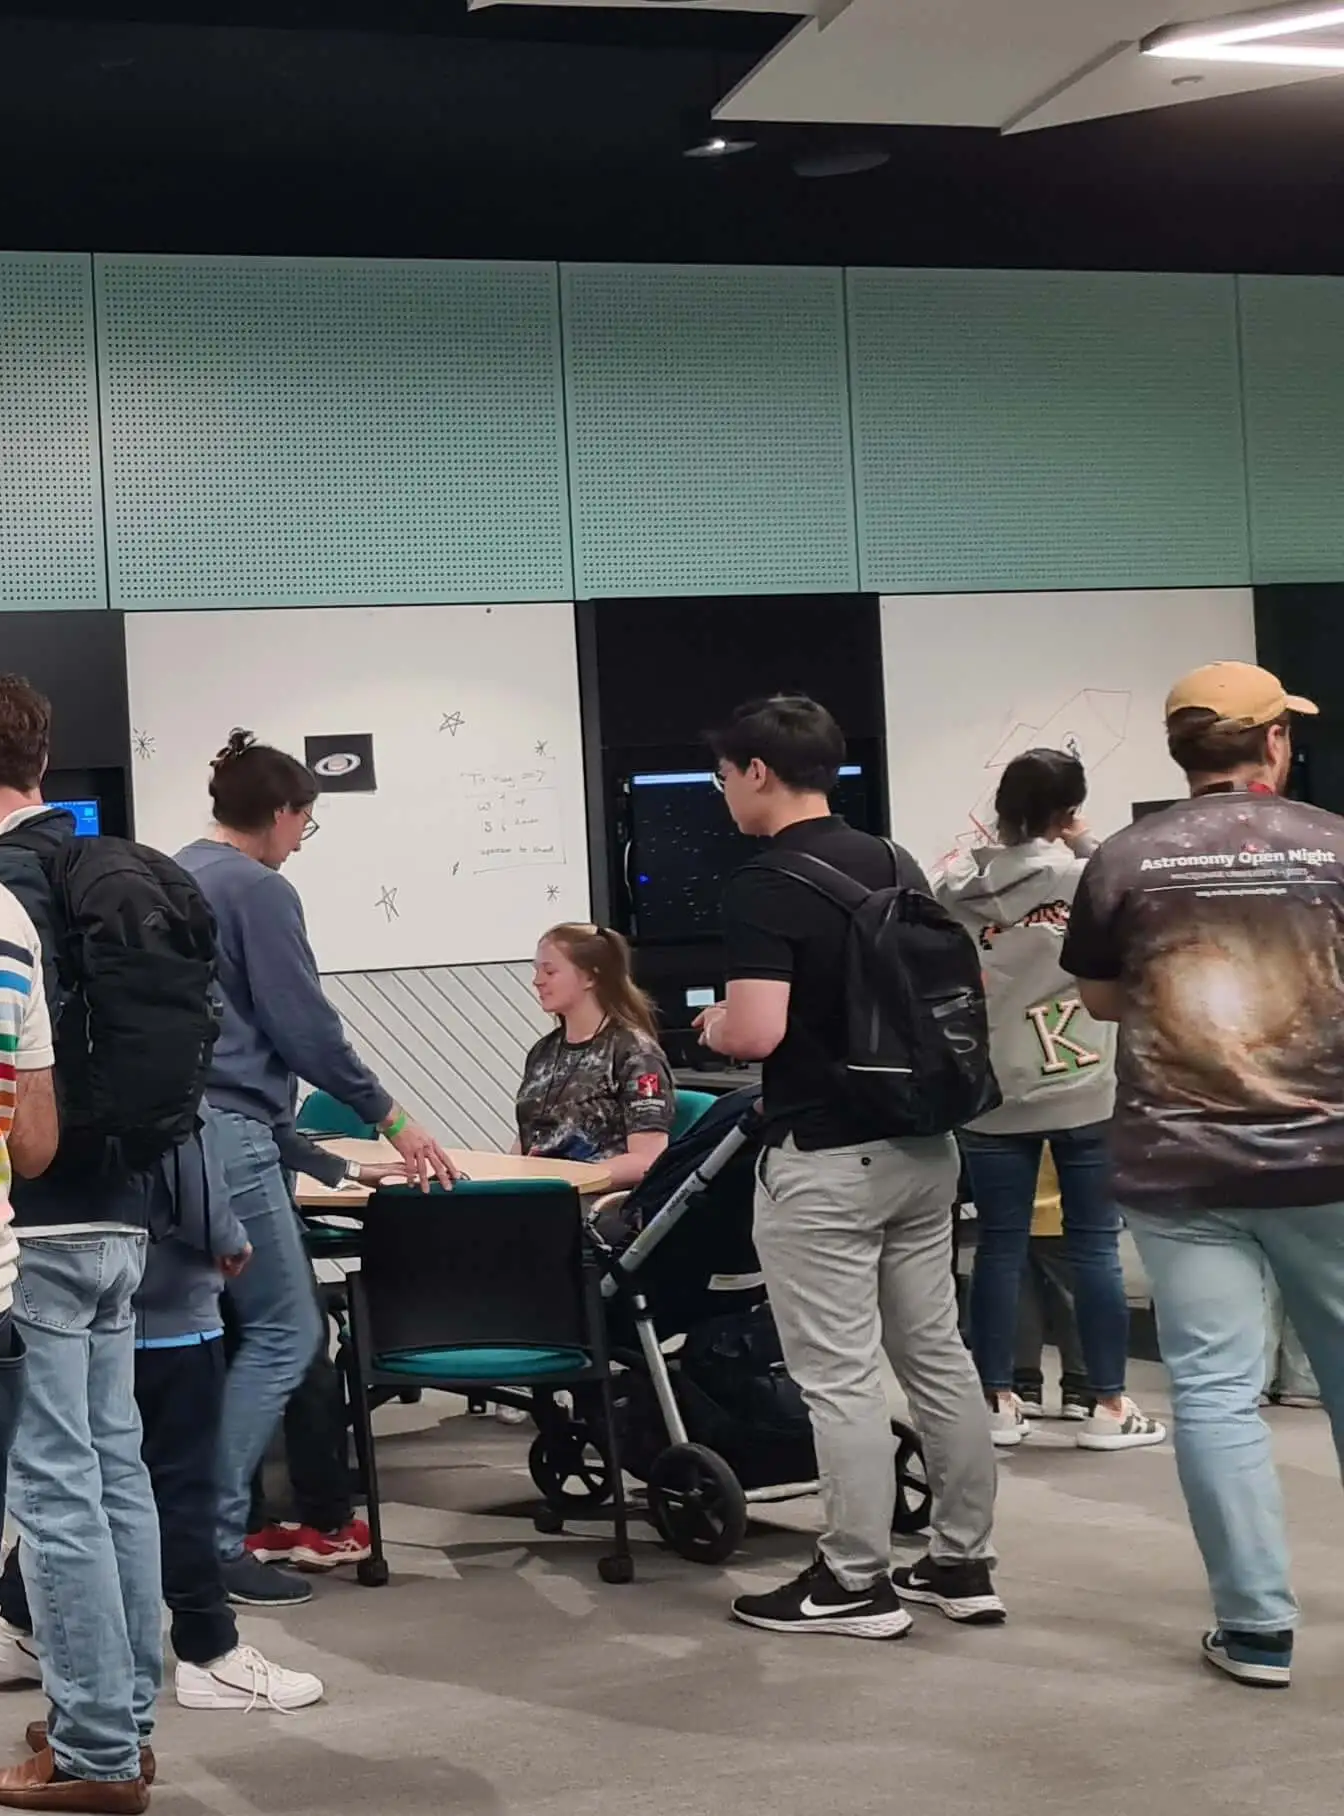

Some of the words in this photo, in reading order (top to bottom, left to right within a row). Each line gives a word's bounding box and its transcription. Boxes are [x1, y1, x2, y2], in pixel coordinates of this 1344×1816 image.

[1140, 853, 1236, 871] Astronomy
[1238, 851, 1286, 867] Open
[1287, 847, 1337, 867] Night
[1024, 998, 1101, 1076] K
